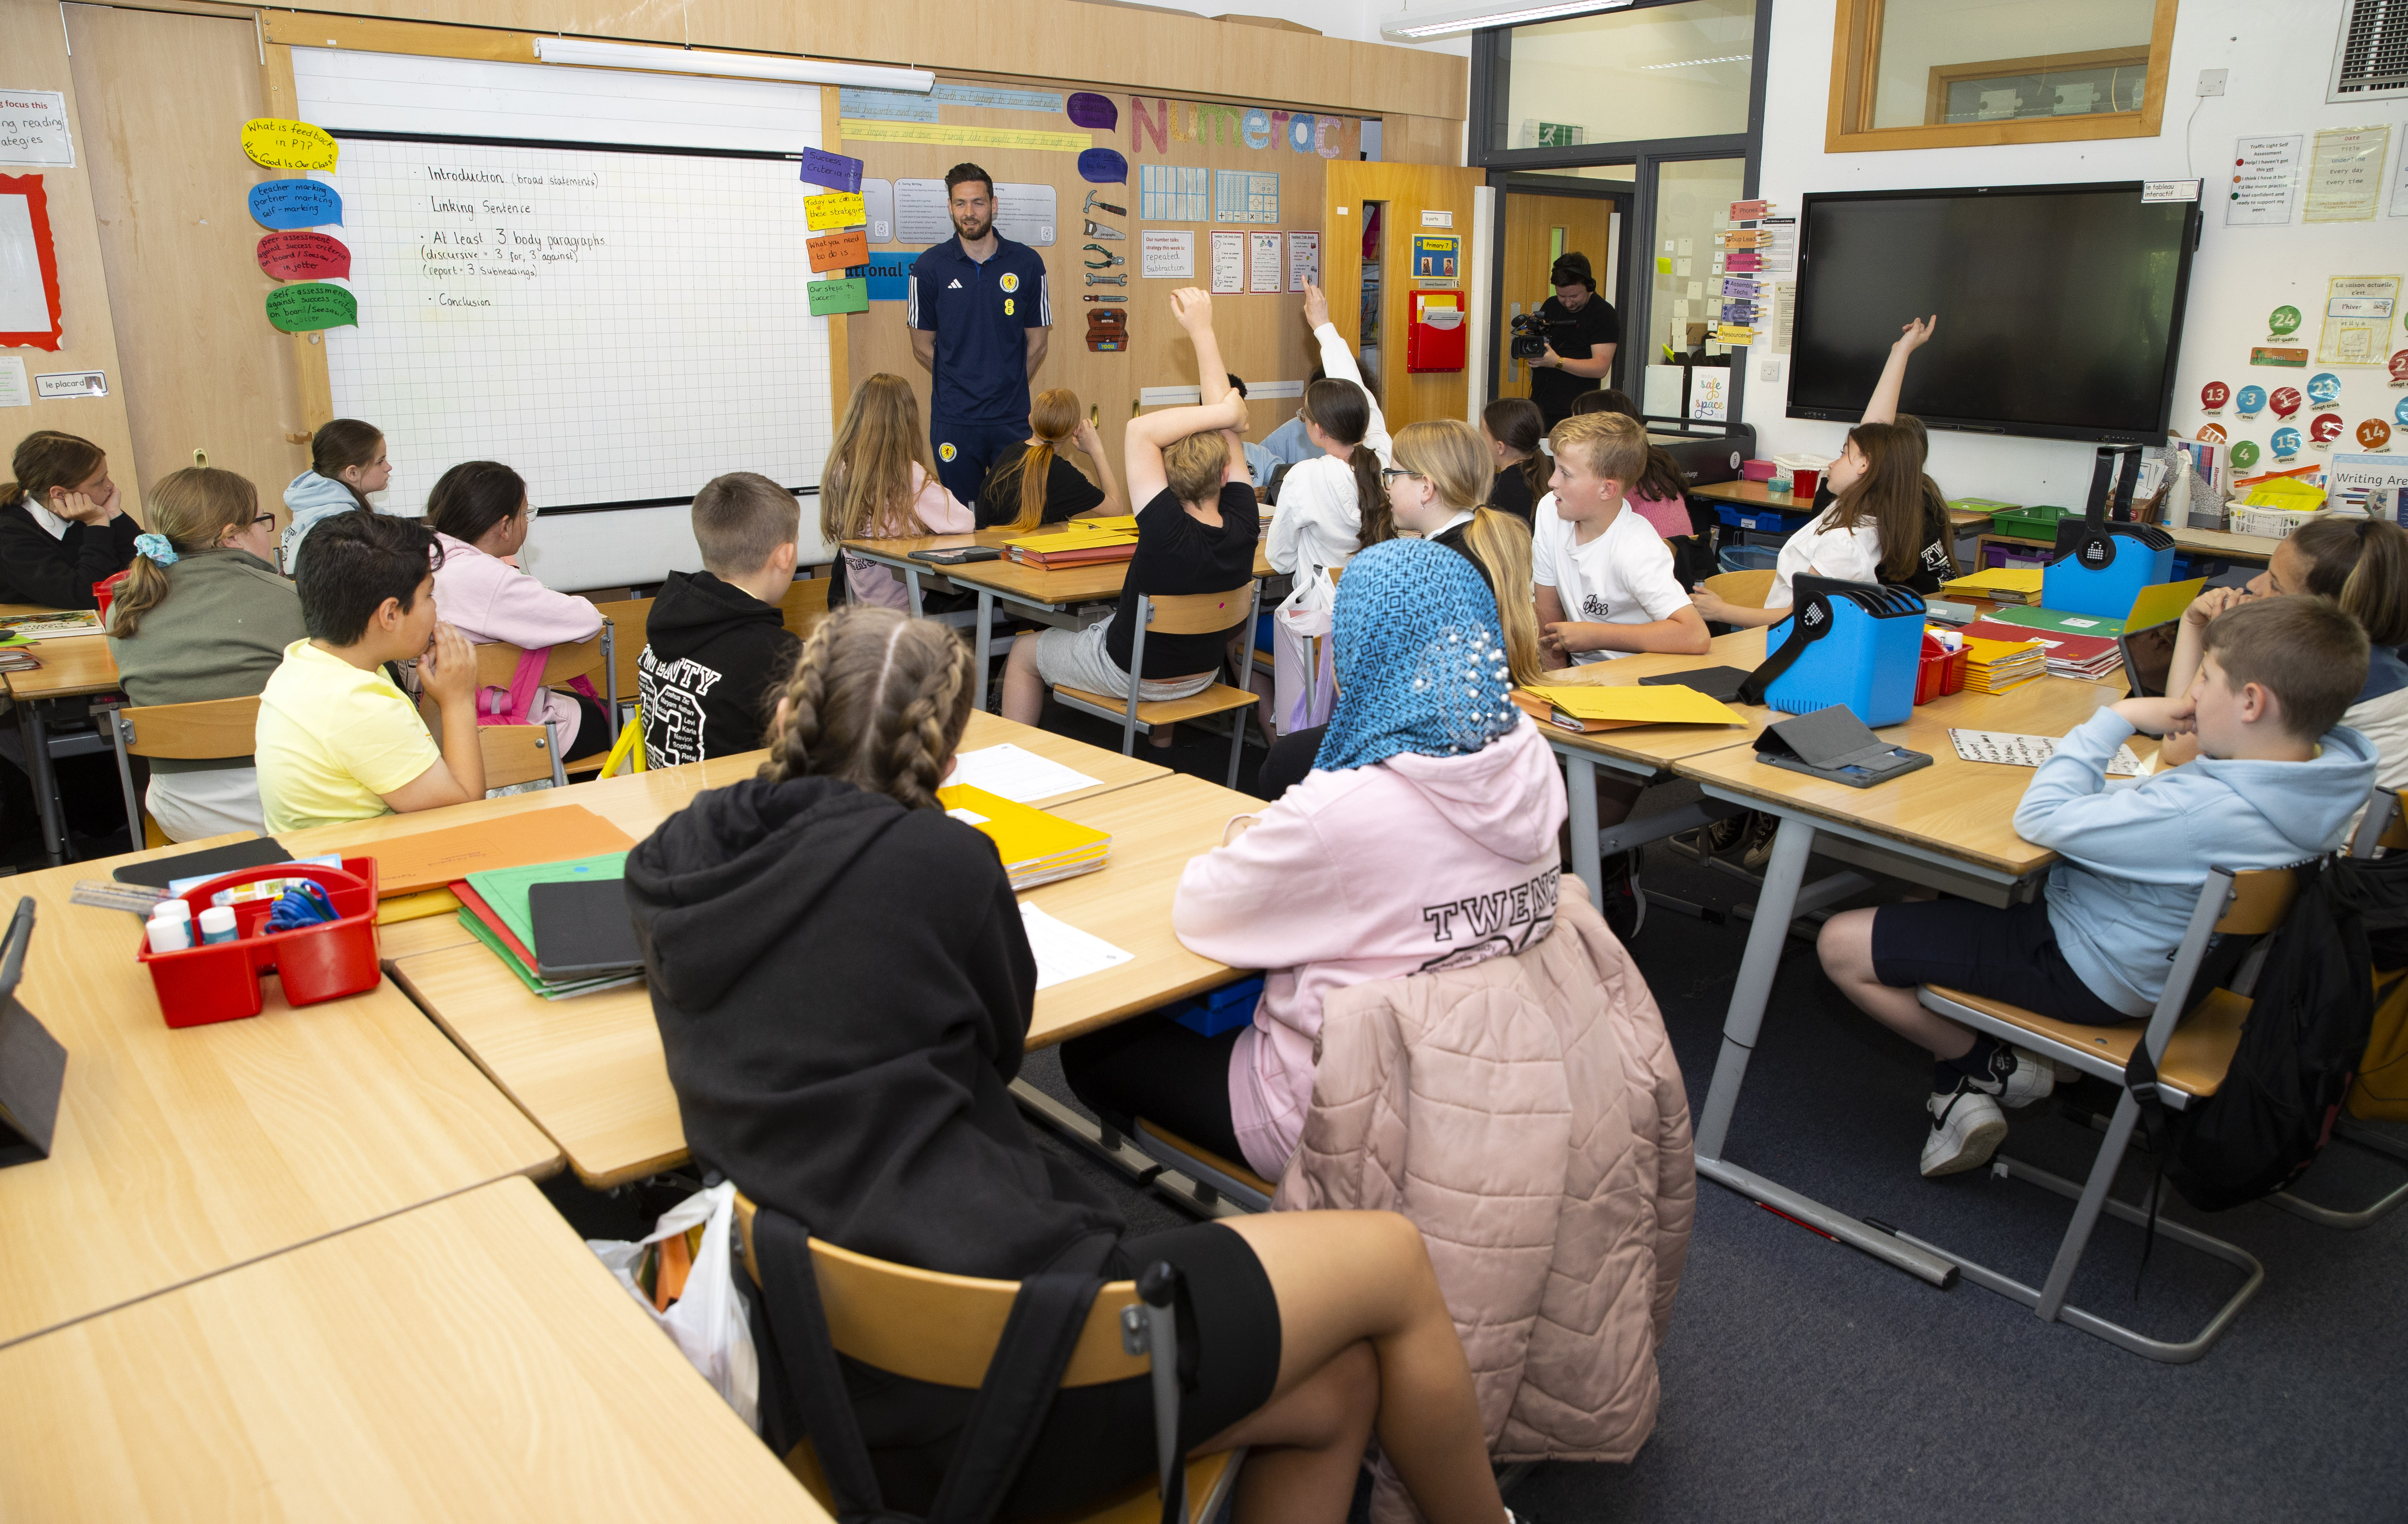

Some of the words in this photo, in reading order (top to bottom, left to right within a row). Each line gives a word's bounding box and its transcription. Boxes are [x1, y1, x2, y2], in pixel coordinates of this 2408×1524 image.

[23, 116, 62, 130] reading
[247, 121, 275, 132] What
[291, 124, 334, 148] feedback
[276, 137, 286, 147] in
[244, 141, 257, 158] How
[260, 153, 281, 166] Good
[810, 152, 841, 165] Success
[808, 164, 842, 177] Criteria
[258, 184, 290, 195] teacher
[296, 184, 326, 197] marking
[254, 195, 288, 210] partner
[295, 194, 332, 207] marking
[431, 196, 474, 221] Linking
[830, 207, 864, 217] strategies
[261, 237, 279, 248] peer
[283, 235, 331, 244] assessment
[433, 231, 448, 244] At
[454, 231, 484, 244] least
[496, 228, 507, 245] 3
[513, 231, 541, 251] body
[809, 240, 827, 249] What
[844, 235, 859, 243] need
[258, 243, 281, 258] against
[316, 244, 346, 260] criteria
[495, 249, 503, 259] 3
[529, 250, 537, 259] 3
[1146, 251, 1180, 264] repeated
[292, 261, 318, 272] jotter
[467, 264, 475, 275] 3
[1730, 281, 1753, 290] Assembly
[440, 293, 491, 306] Conclusion
[268, 297, 295, 310] against
[334, 298, 355, 319] criteria
[2274, 314, 2295, 327] 24
[55, 379, 84, 389] placard
[1700, 378, 1722, 400] safe
[2313, 382, 2334, 393] 23
[2206, 389, 2224, 401] 13
[2246, 393, 2256, 406] 3
[1695, 400, 1724, 419] space
[2362, 426, 2385, 441] 14
[2276, 434, 2296, 449] 15
[2239, 448, 2250, 460] 4
[2337, 473, 2382, 487] Writing
[2387, 476, 2408, 485] Are
[665, 690, 681, 701] Joshua
[682, 697, 690, 705] Zac
[661, 697, 677, 709] Maryam
[679, 704, 694, 716] Nathan
[684, 717, 695, 726] Levi
[682, 726, 697, 735] Karla
[674, 733, 693, 742] Navjot
[672, 742, 693, 751] Sophie
[682, 753, 697, 762] Retaj
[1423, 865, 1561, 942] TWENT
